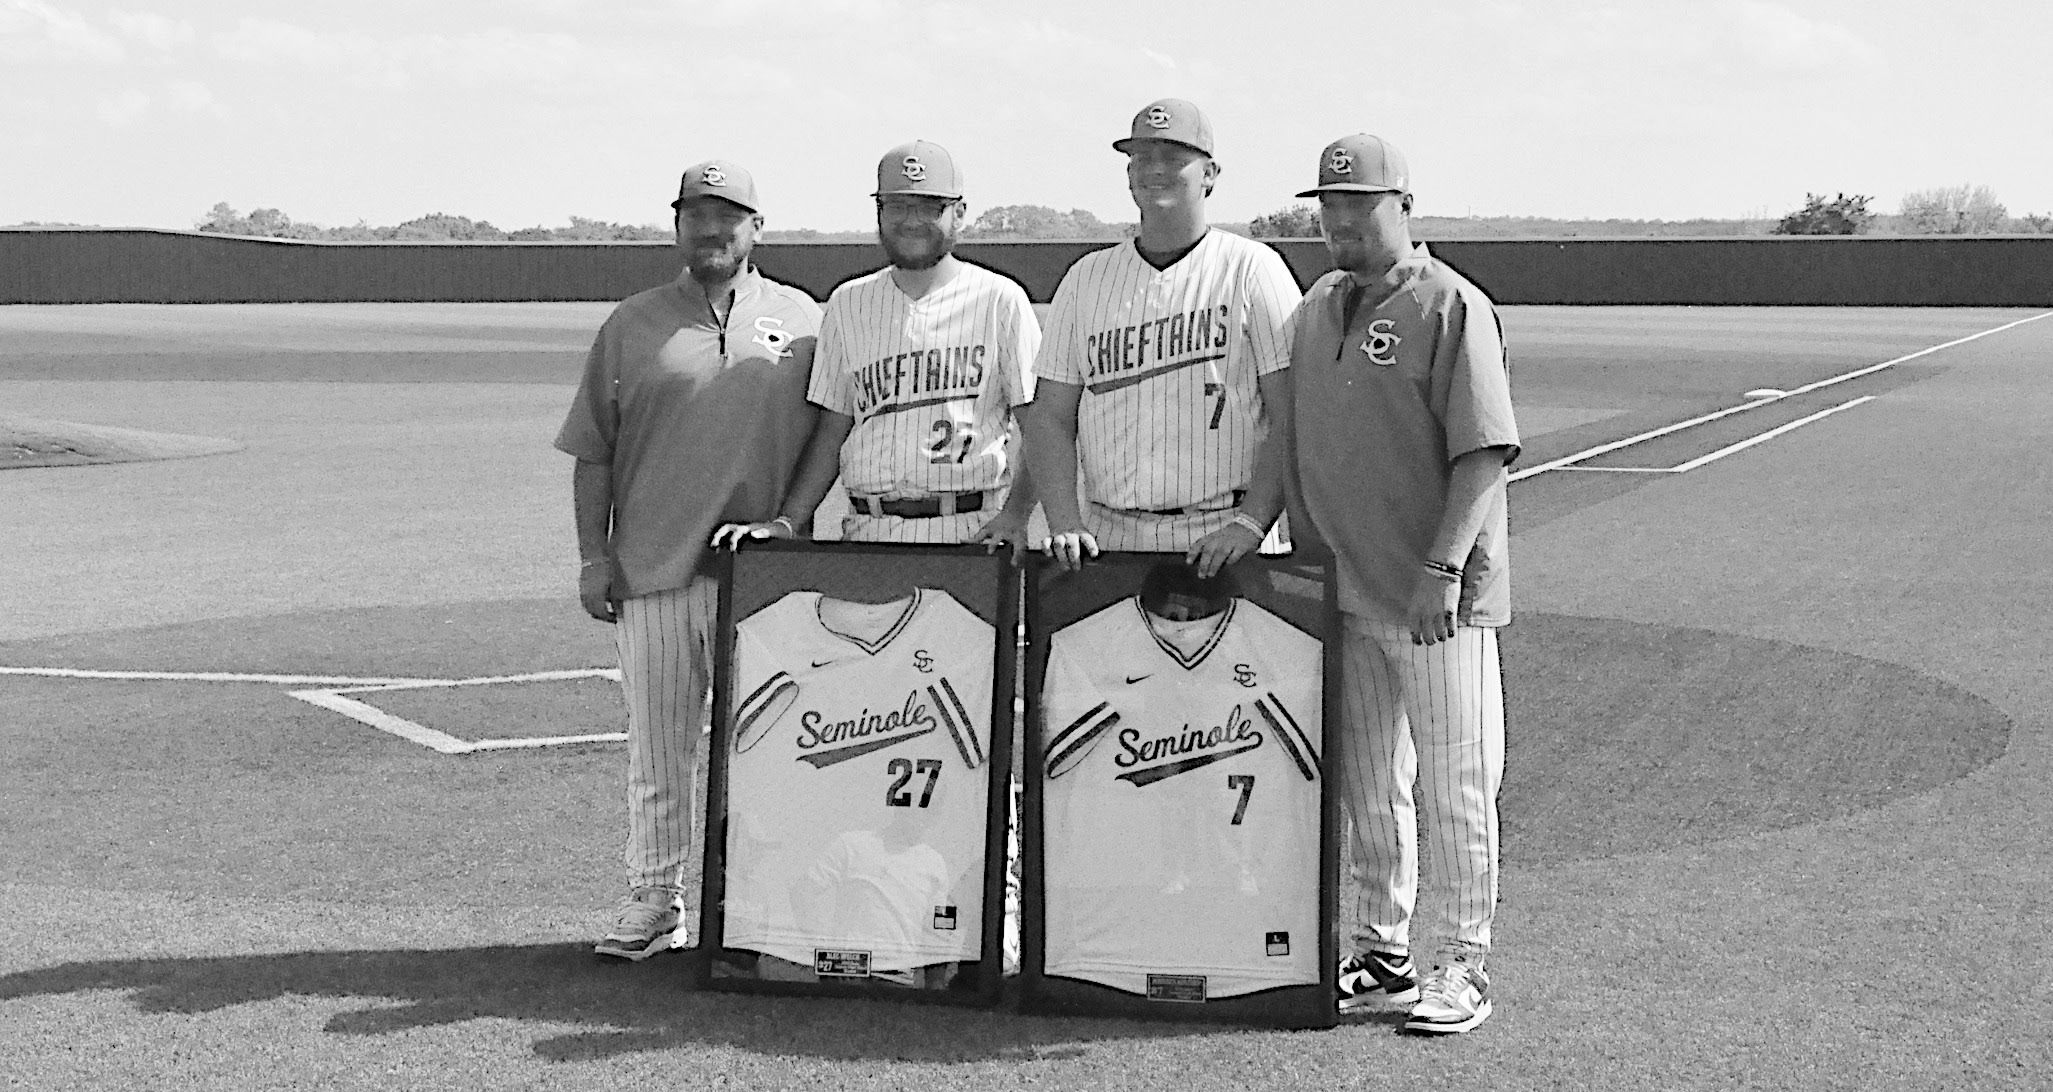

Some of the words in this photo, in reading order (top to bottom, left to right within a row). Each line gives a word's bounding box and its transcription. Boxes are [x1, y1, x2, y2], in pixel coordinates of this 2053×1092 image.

[1087, 304, 1228, 378] CHIEFTAINS
[853, 344, 986, 413] CHIEFTAINS
[1204, 383, 1226, 429] 7
[930, 419, 973, 464] 27
[796, 689, 937, 749] Seminole
[1114, 704, 1263, 768] Seminole
[886, 758, 943, 808] 27
[1228, 775, 1255, 825] 7
